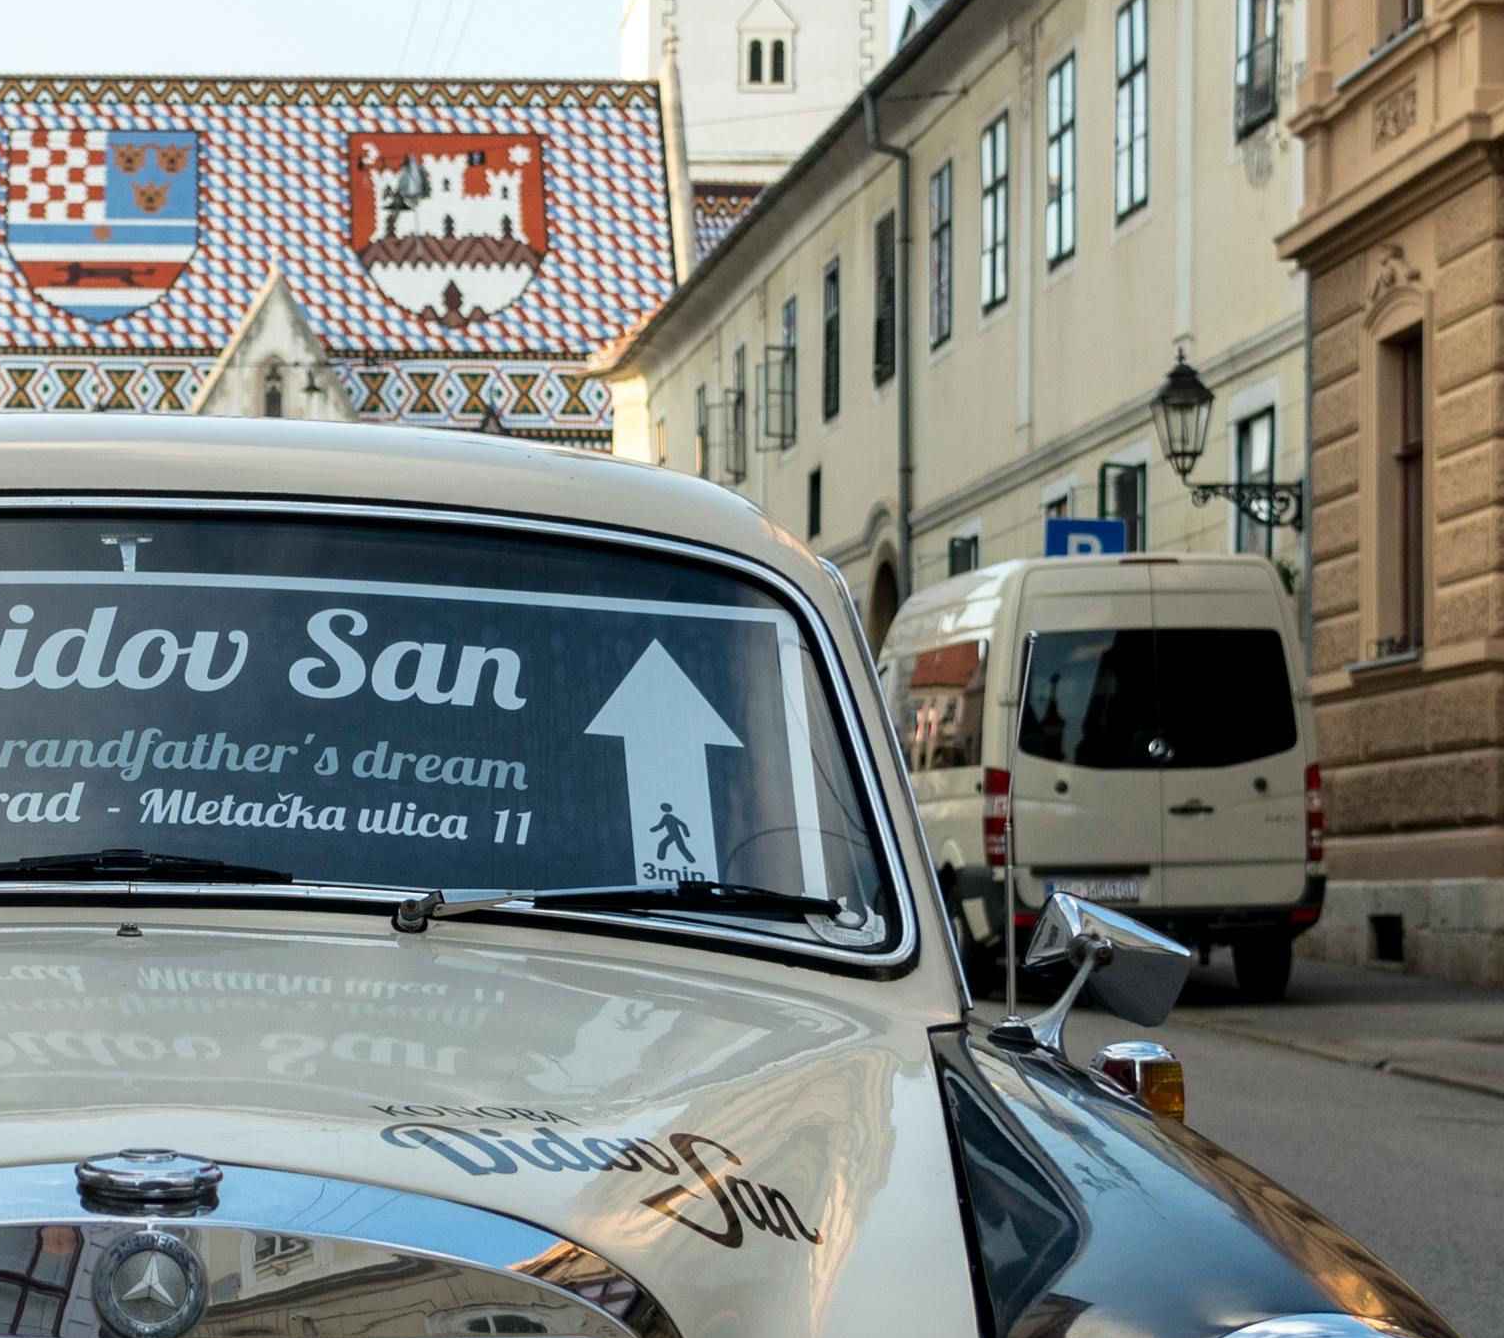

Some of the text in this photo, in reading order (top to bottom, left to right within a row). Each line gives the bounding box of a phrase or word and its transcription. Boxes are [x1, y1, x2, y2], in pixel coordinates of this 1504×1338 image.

[288, 607, 527, 711] San
[352, 739, 528, 791] dream
[138, 787, 347, 833] Mletačka
[357, 801, 469, 841] ulica
[493, 809, 533, 846] 11
[642, 862, 706, 882] 3min
[373, 1104, 582, 1128] KONOBA
[379, 1122, 680, 1177] Didov
[638, 1132, 825, 1249] San
